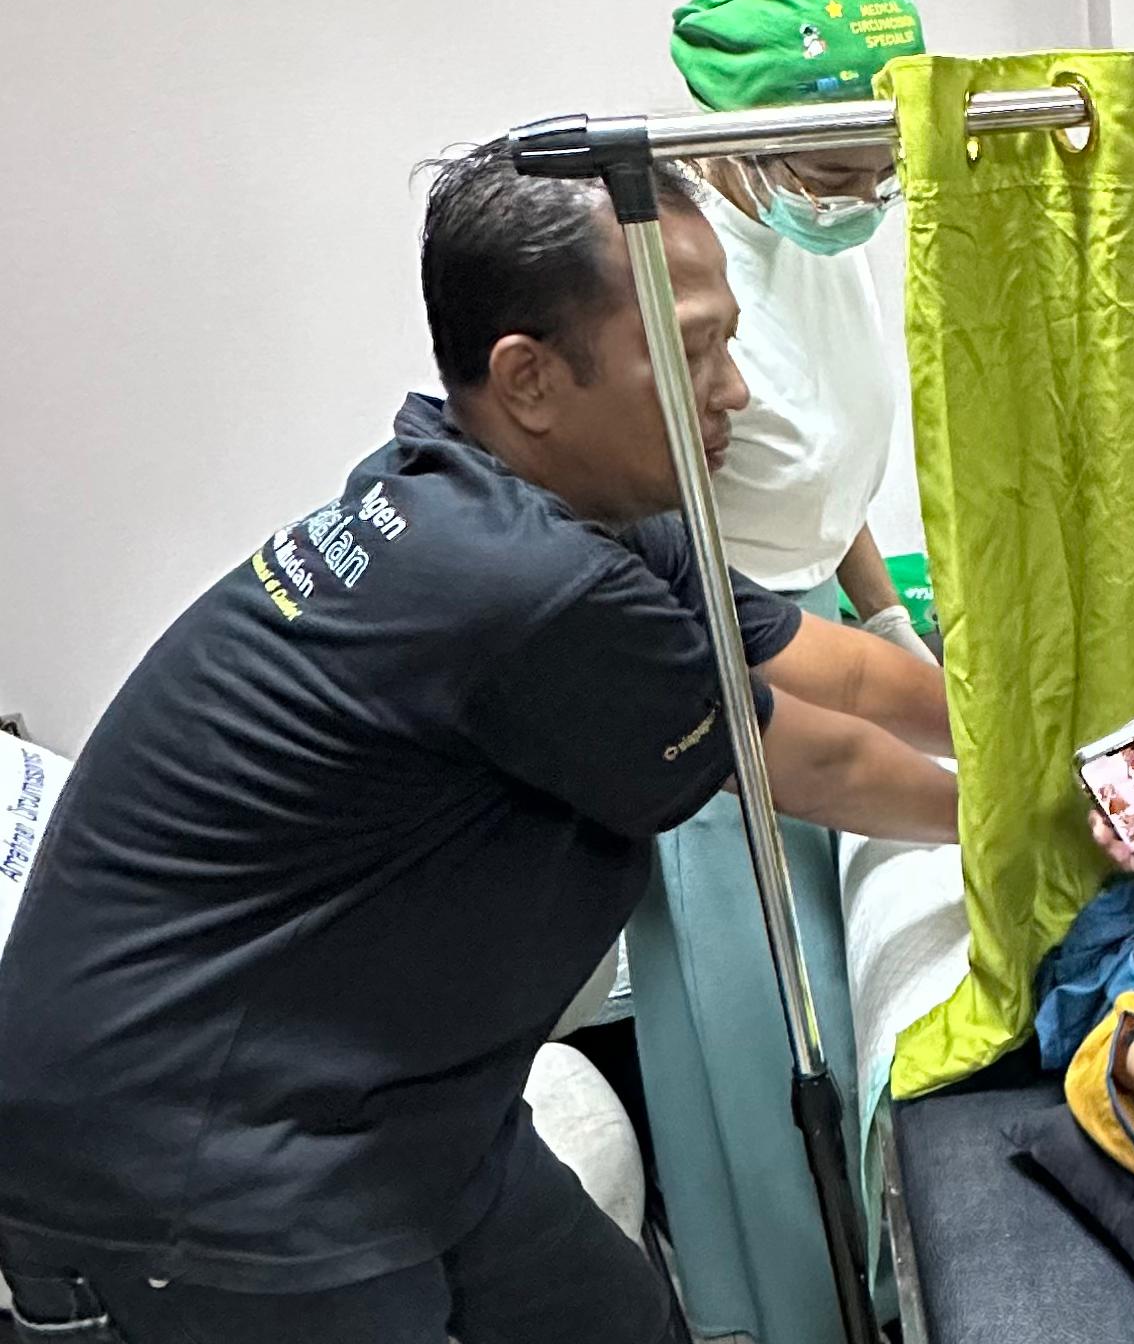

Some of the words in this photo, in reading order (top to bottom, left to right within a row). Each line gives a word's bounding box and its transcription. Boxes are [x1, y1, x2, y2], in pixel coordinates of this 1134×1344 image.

[860, 1, 902, 17] MEDICAL
[358, 481, 408, 541] Agen
[275, 539, 314, 599] Mudah
